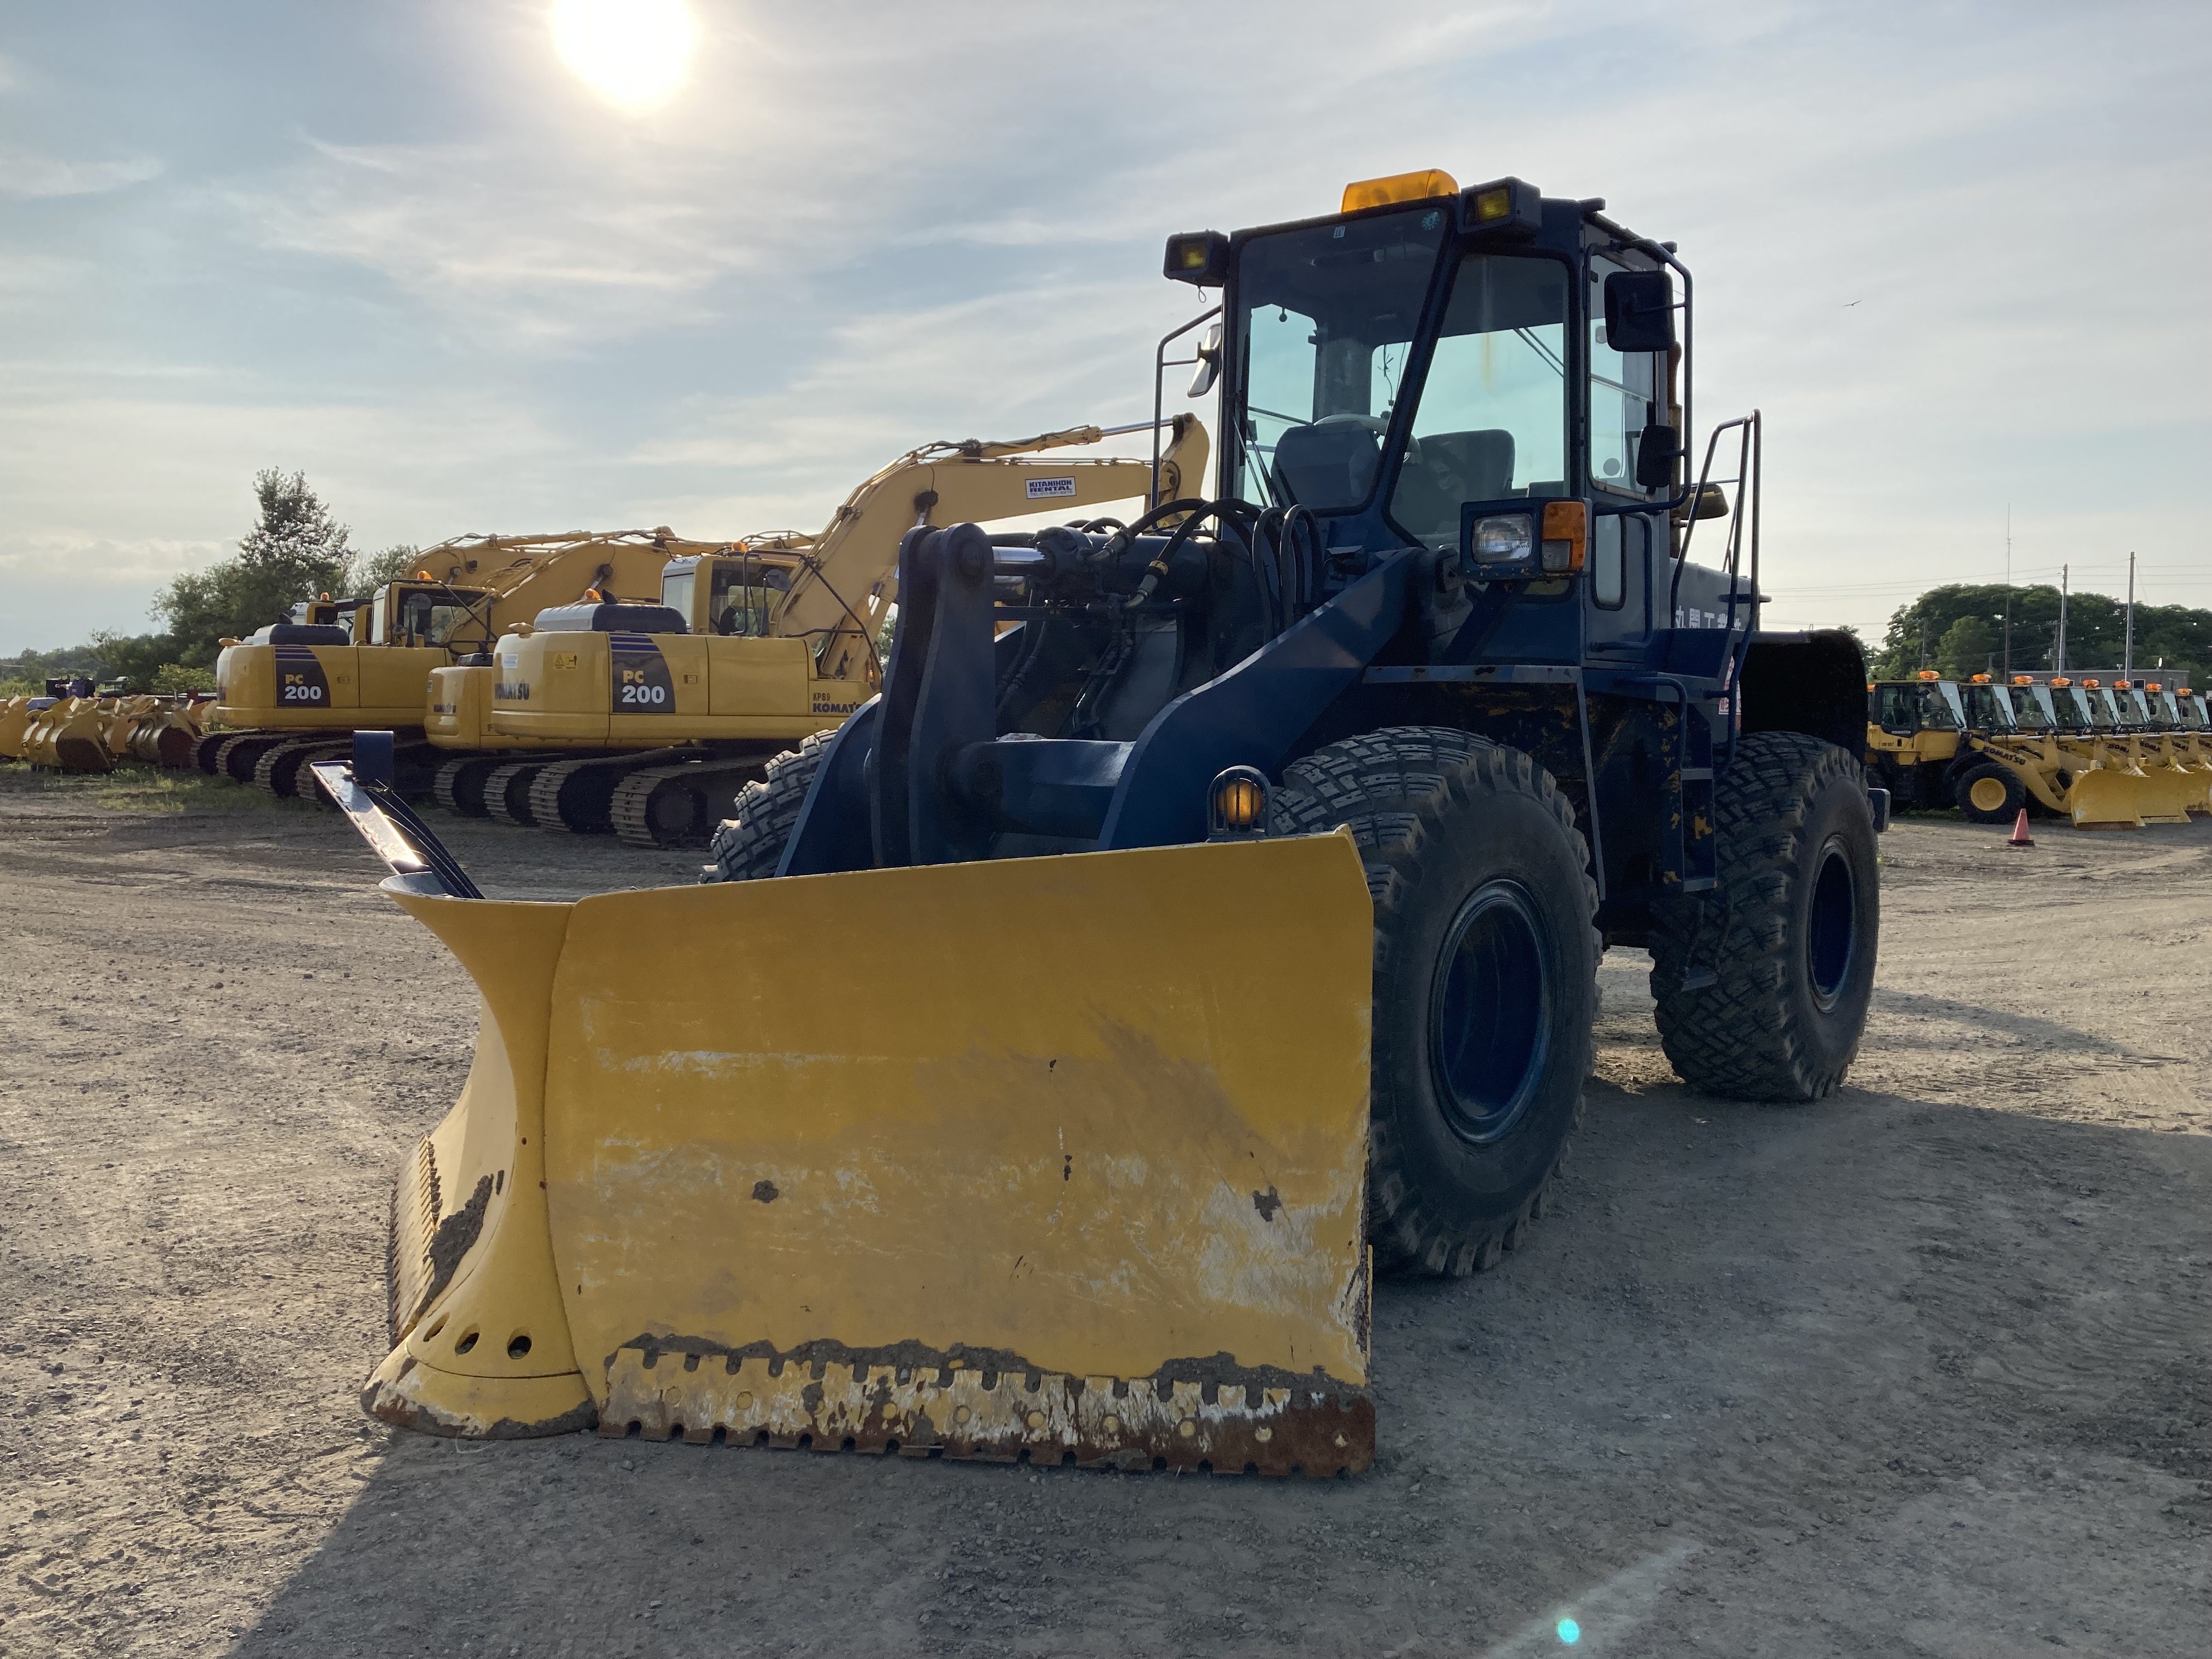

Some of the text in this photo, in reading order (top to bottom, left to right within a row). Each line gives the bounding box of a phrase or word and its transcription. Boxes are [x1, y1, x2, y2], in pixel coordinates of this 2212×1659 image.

[285, 674, 303, 685] PC
[623, 670, 644, 684] PC
[285, 686, 321, 699] 200
[622, 685, 665, 703] 200
[813, 702, 862, 713] KOMAT
